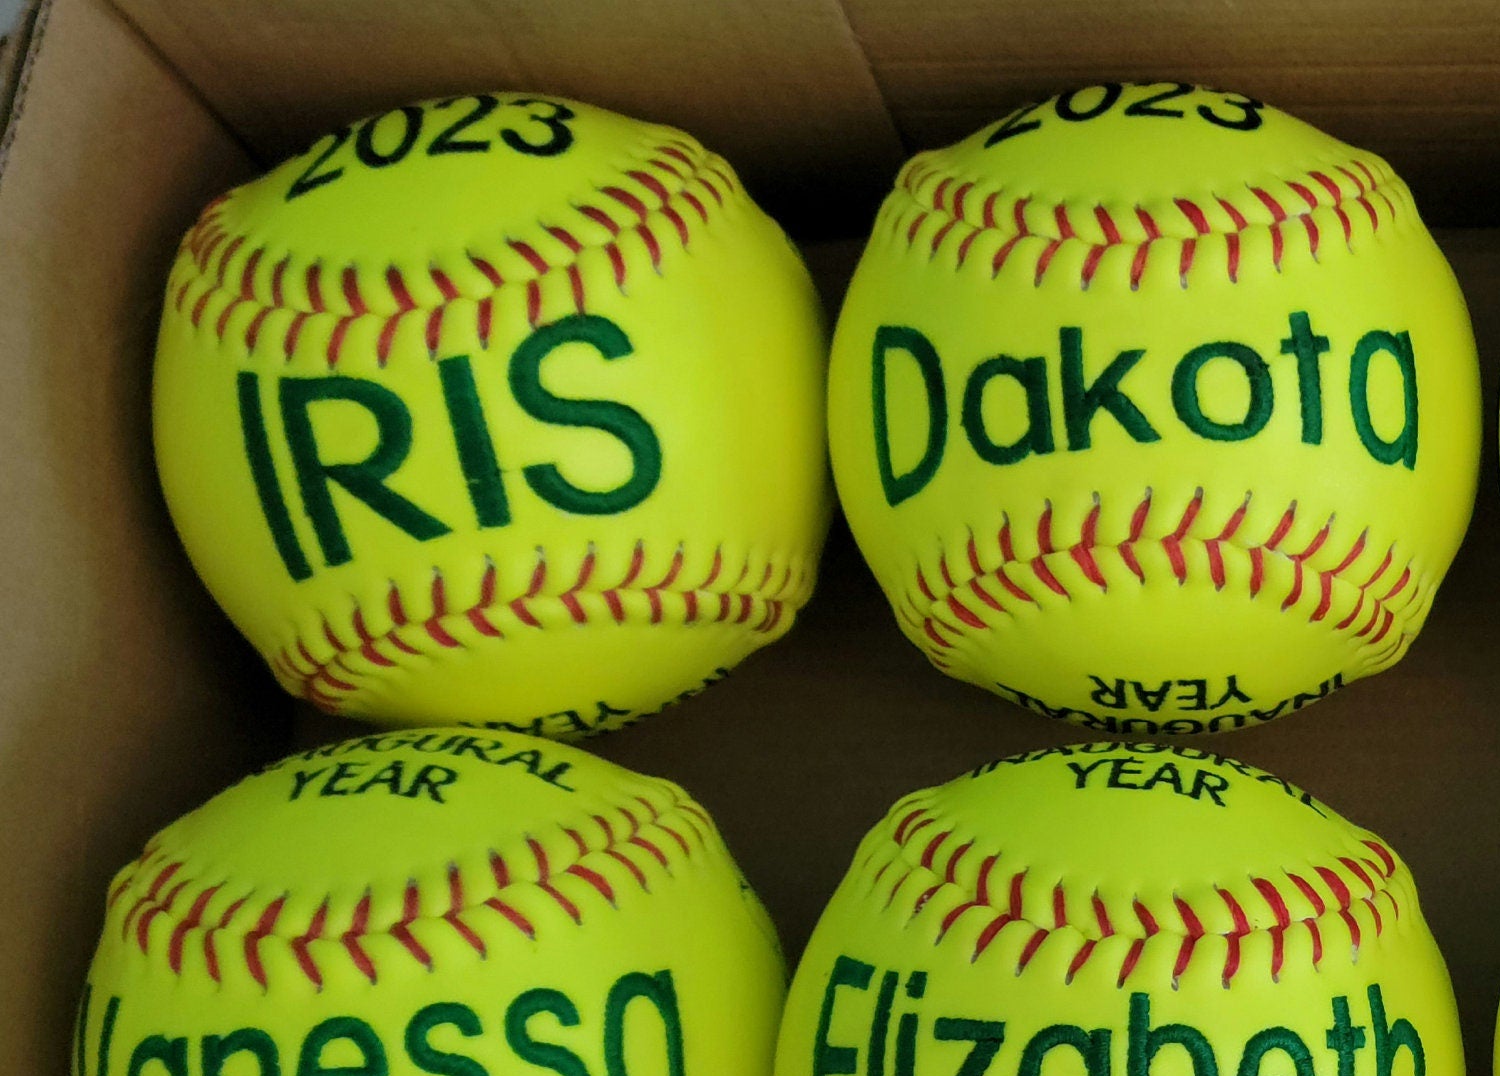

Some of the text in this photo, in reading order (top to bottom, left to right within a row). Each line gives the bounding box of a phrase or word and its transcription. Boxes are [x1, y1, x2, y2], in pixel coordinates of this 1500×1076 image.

[285, 95, 575, 202] 2023
[984, 78, 1263, 149] 2023
[872, 310, 1420, 508] Dakota
[236, 314, 663, 582] IRIS
[1088, 674, 1253, 712] YEAR
[289, 760, 458, 805] YEAR
[1066, 757, 1230, 808] YEAR
